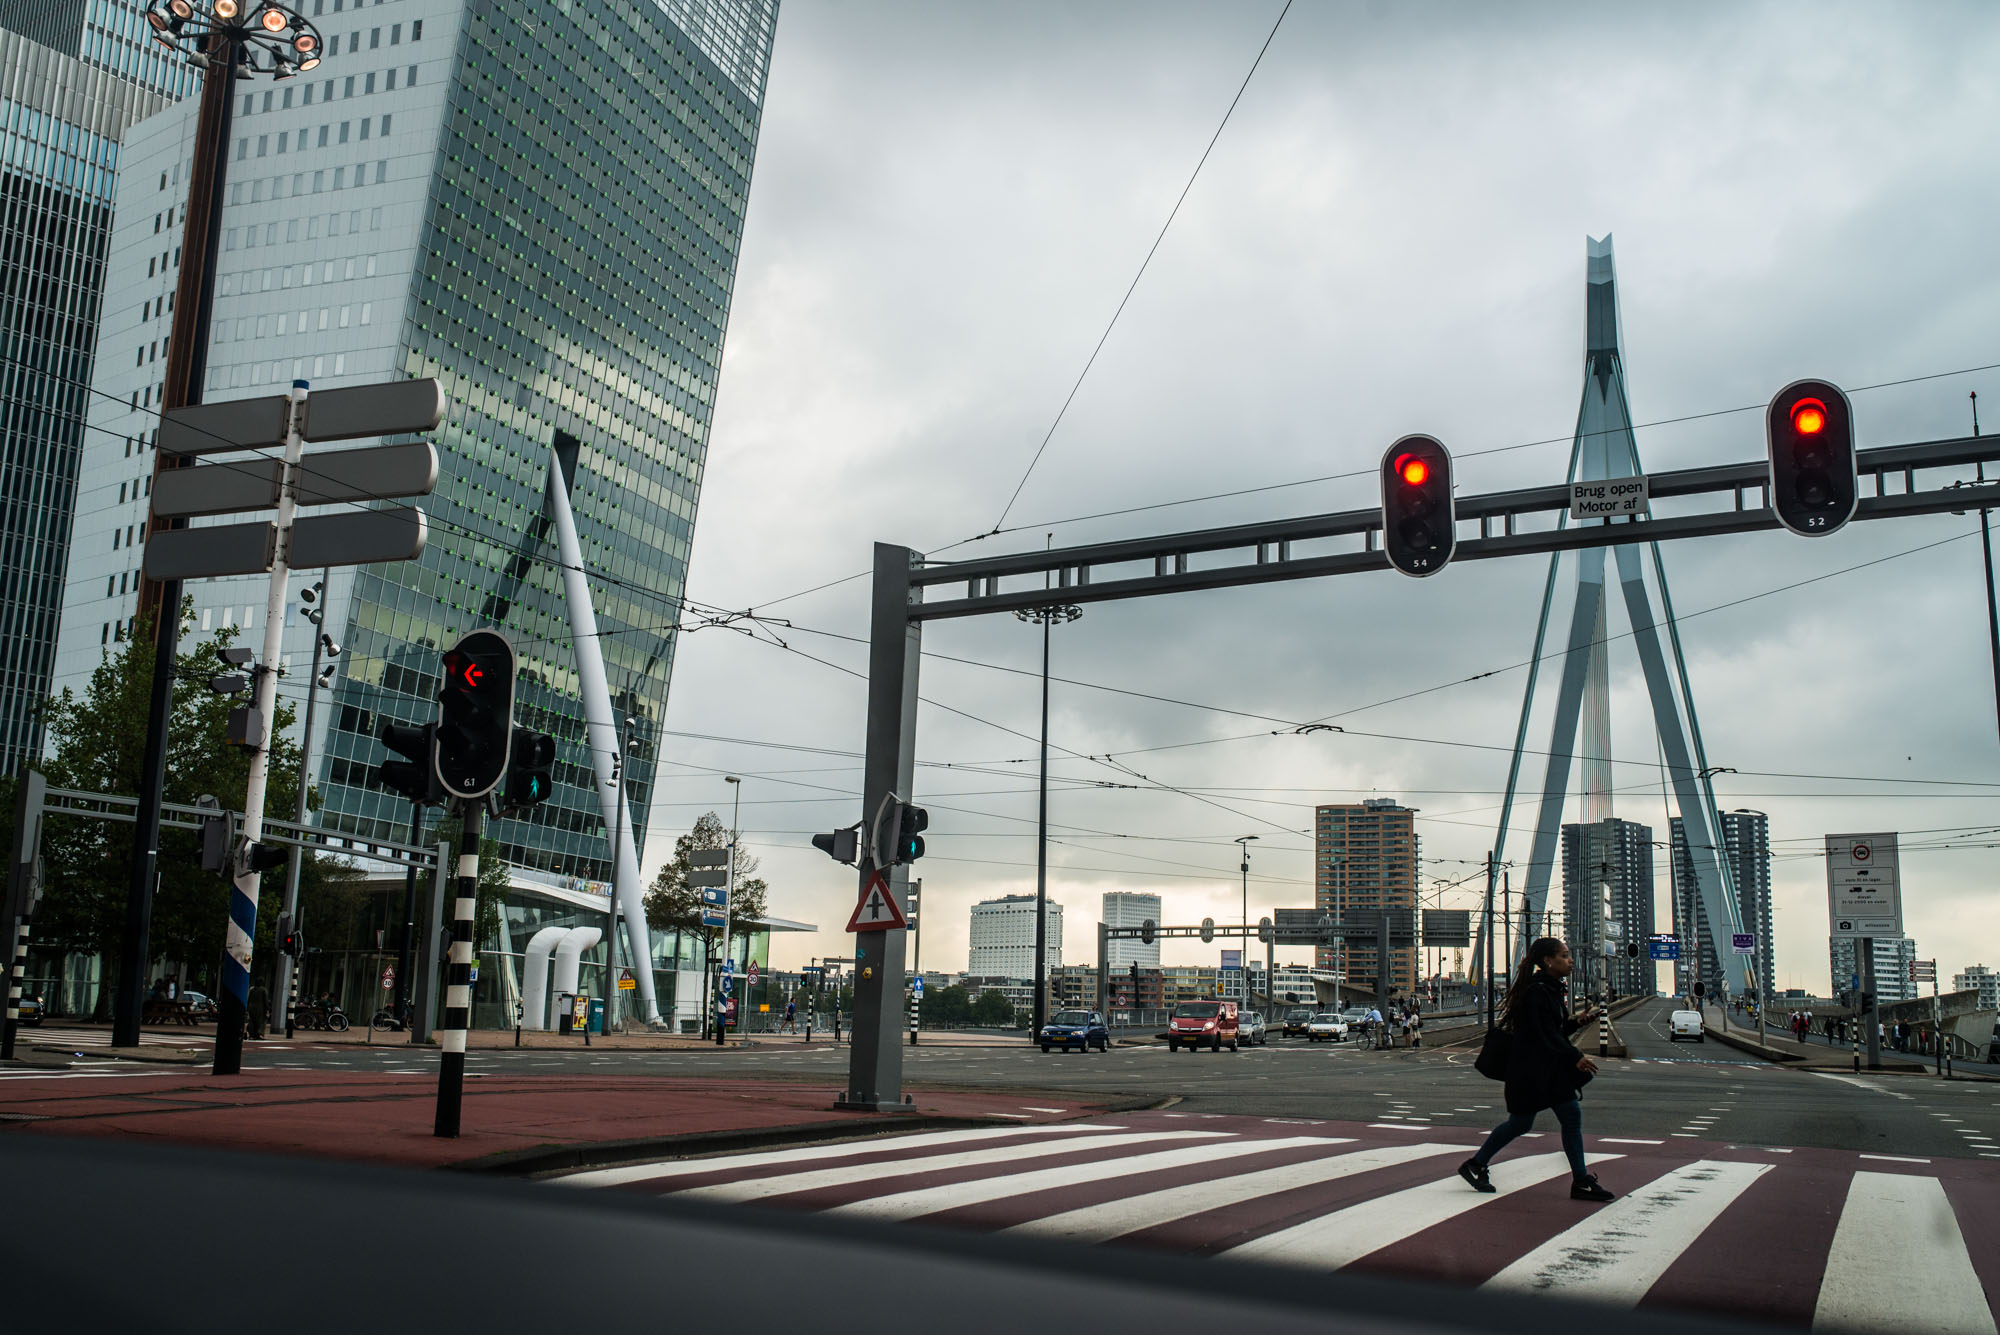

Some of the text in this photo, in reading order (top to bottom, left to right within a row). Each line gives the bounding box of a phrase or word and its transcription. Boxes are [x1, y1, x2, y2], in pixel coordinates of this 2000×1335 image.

[1575, 483, 1643, 498] Brug open
[1579, 497, 1638, 513] Motor af
